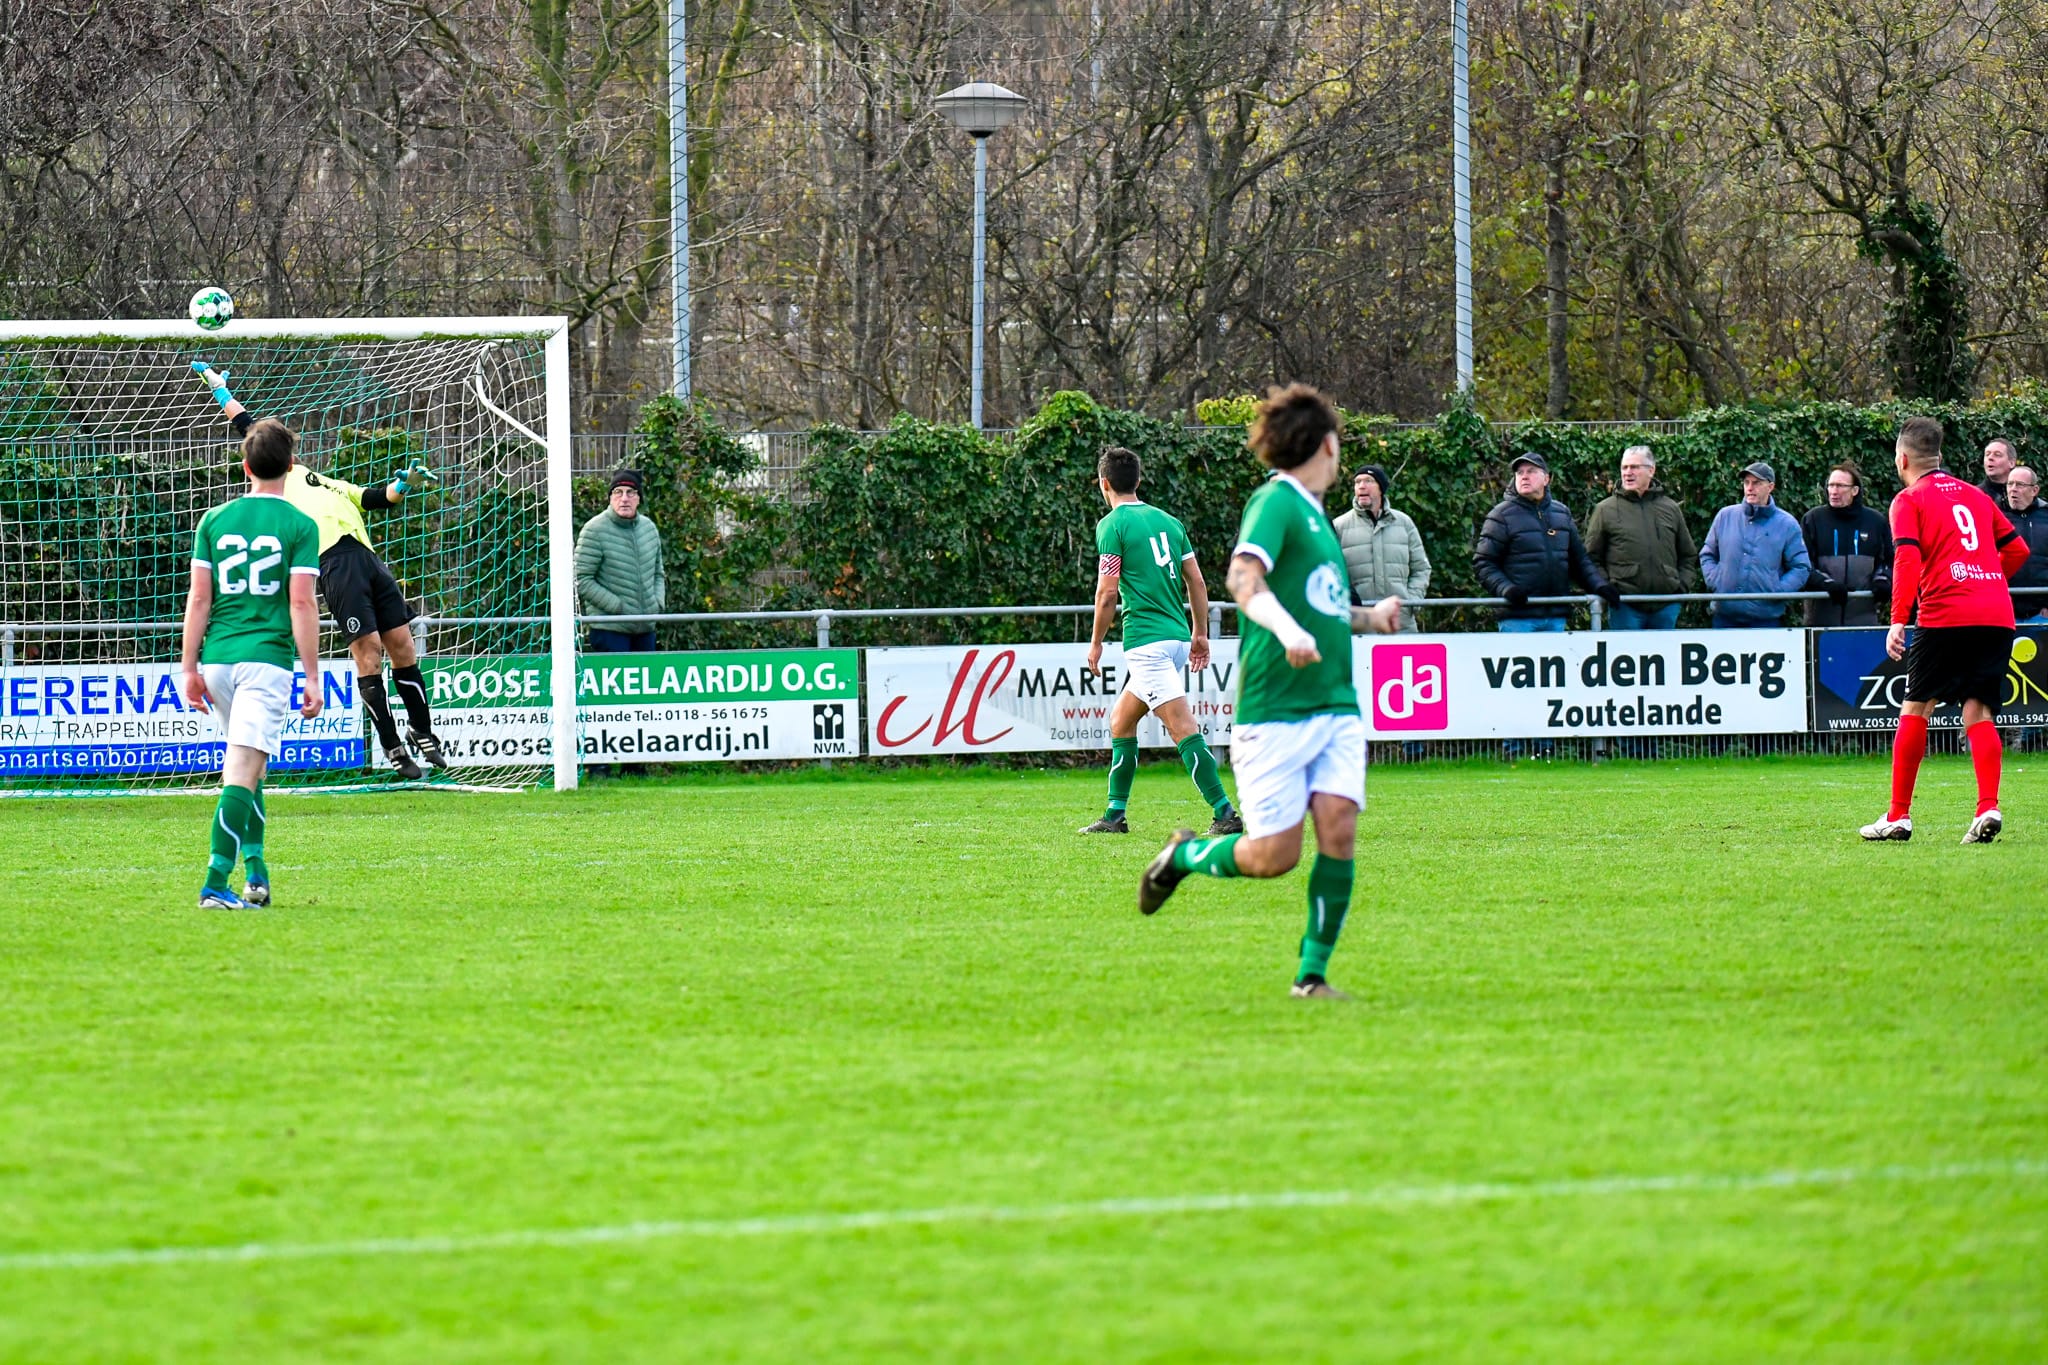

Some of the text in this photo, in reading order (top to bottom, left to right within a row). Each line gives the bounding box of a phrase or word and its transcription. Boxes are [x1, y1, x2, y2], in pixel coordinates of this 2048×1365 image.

[1952, 504, 1979, 552] 9
[216, 534, 283, 597] 22
[1150, 531, 1177, 579] 4
[1967, 564, 1984, 573] ALL
[1968, 572, 2002, 581] SAFETY
[432, 662, 846, 700] ROOSE AKELAARDIJ O.G.
[1017, 661, 1131, 695] MARE
[1481, 641, 1786, 699] van den Berg
[1377, 655, 1442, 720] da
[467, 714, 489, 727] 43,
[492, 713, 526, 726] 4374
[530, 713, 549, 725] AB
[634, 709, 661, 722] Tel.:
[665, 708, 699, 722] 0118
[711, 708, 728, 720] 56
[731, 707, 748, 719] 16
[752, 707, 768, 719] 75
[1547, 695, 1723, 728] Zoutelande
[53, 719, 199, 739] TRAPPENIERS
[1051, 727, 1111, 740] Zoutelan
[814, 742, 845, 754] NVM
